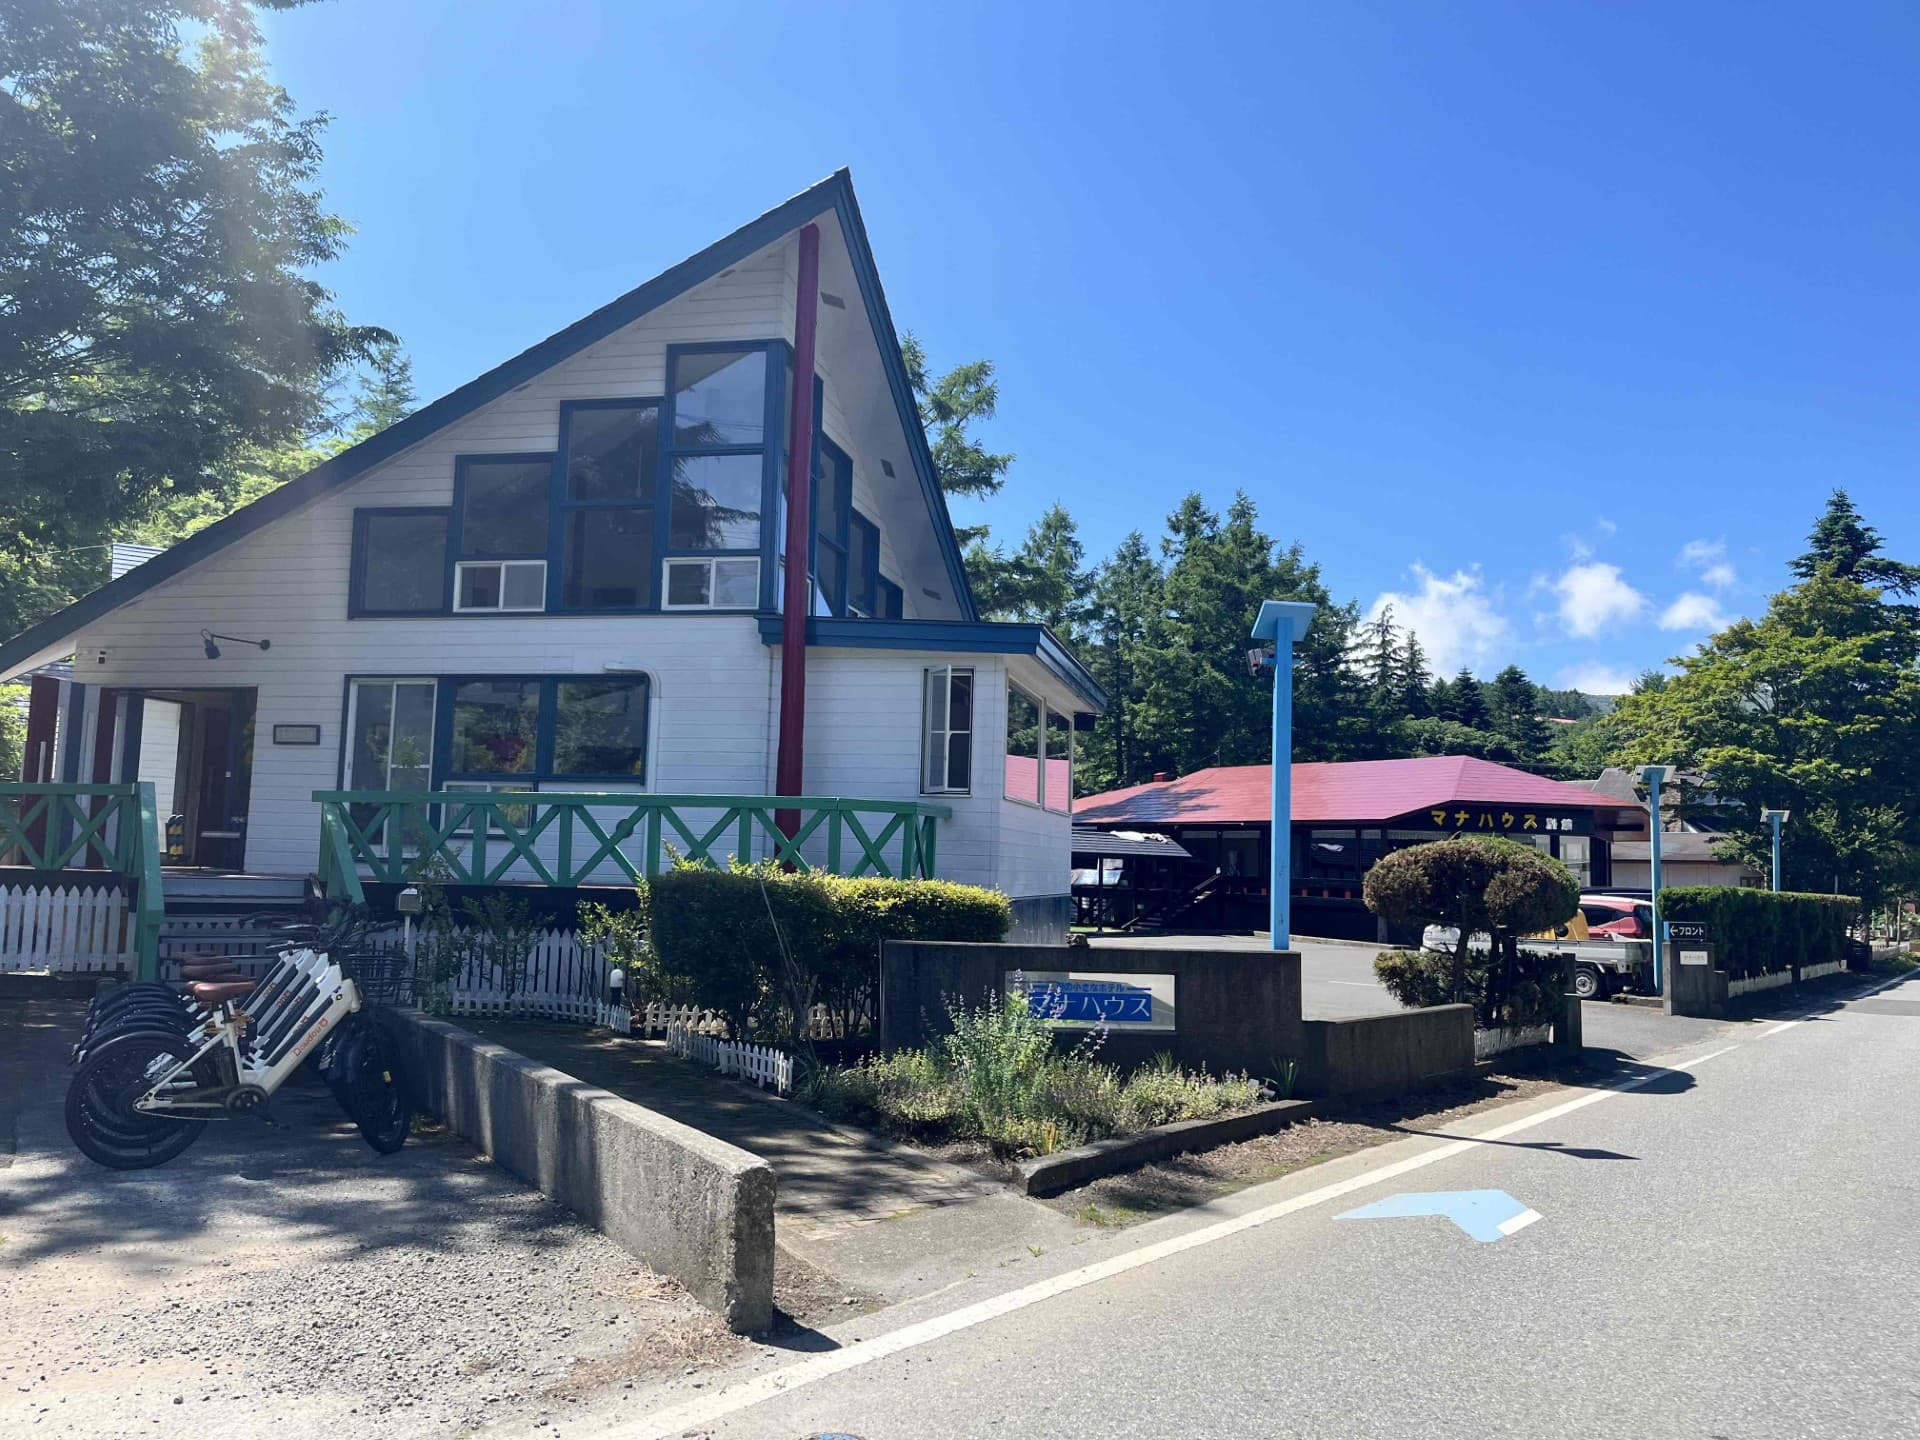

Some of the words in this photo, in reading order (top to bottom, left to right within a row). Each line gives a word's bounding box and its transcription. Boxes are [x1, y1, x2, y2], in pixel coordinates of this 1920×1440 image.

[1431, 810, 1538, 830] マナハウス
[1678, 926, 1704, 936] フロント
[1029, 994, 1150, 1017] マナハウス
